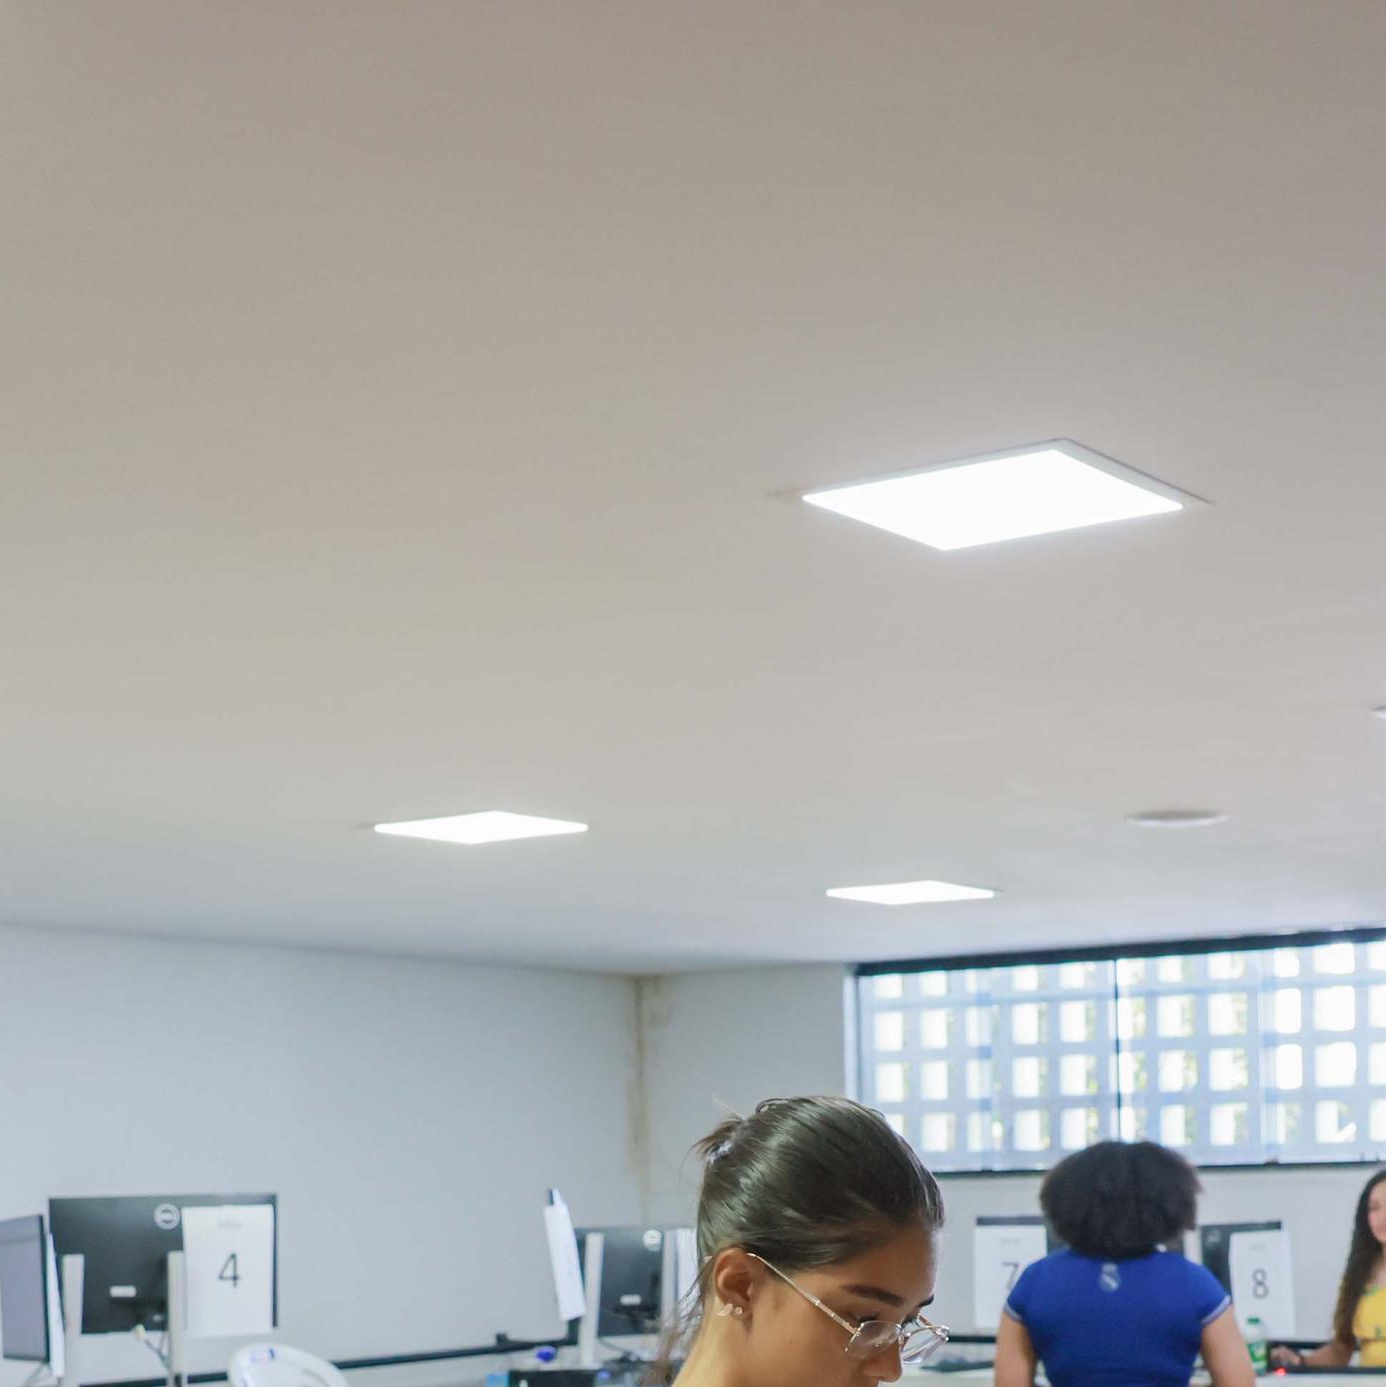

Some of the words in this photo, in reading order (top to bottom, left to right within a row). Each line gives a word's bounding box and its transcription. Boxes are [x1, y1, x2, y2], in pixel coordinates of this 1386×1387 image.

[218, 1252, 241, 1289] 4
[1001, 1262, 1019, 1290] 7
[1252, 1268, 1269, 1299] 8
